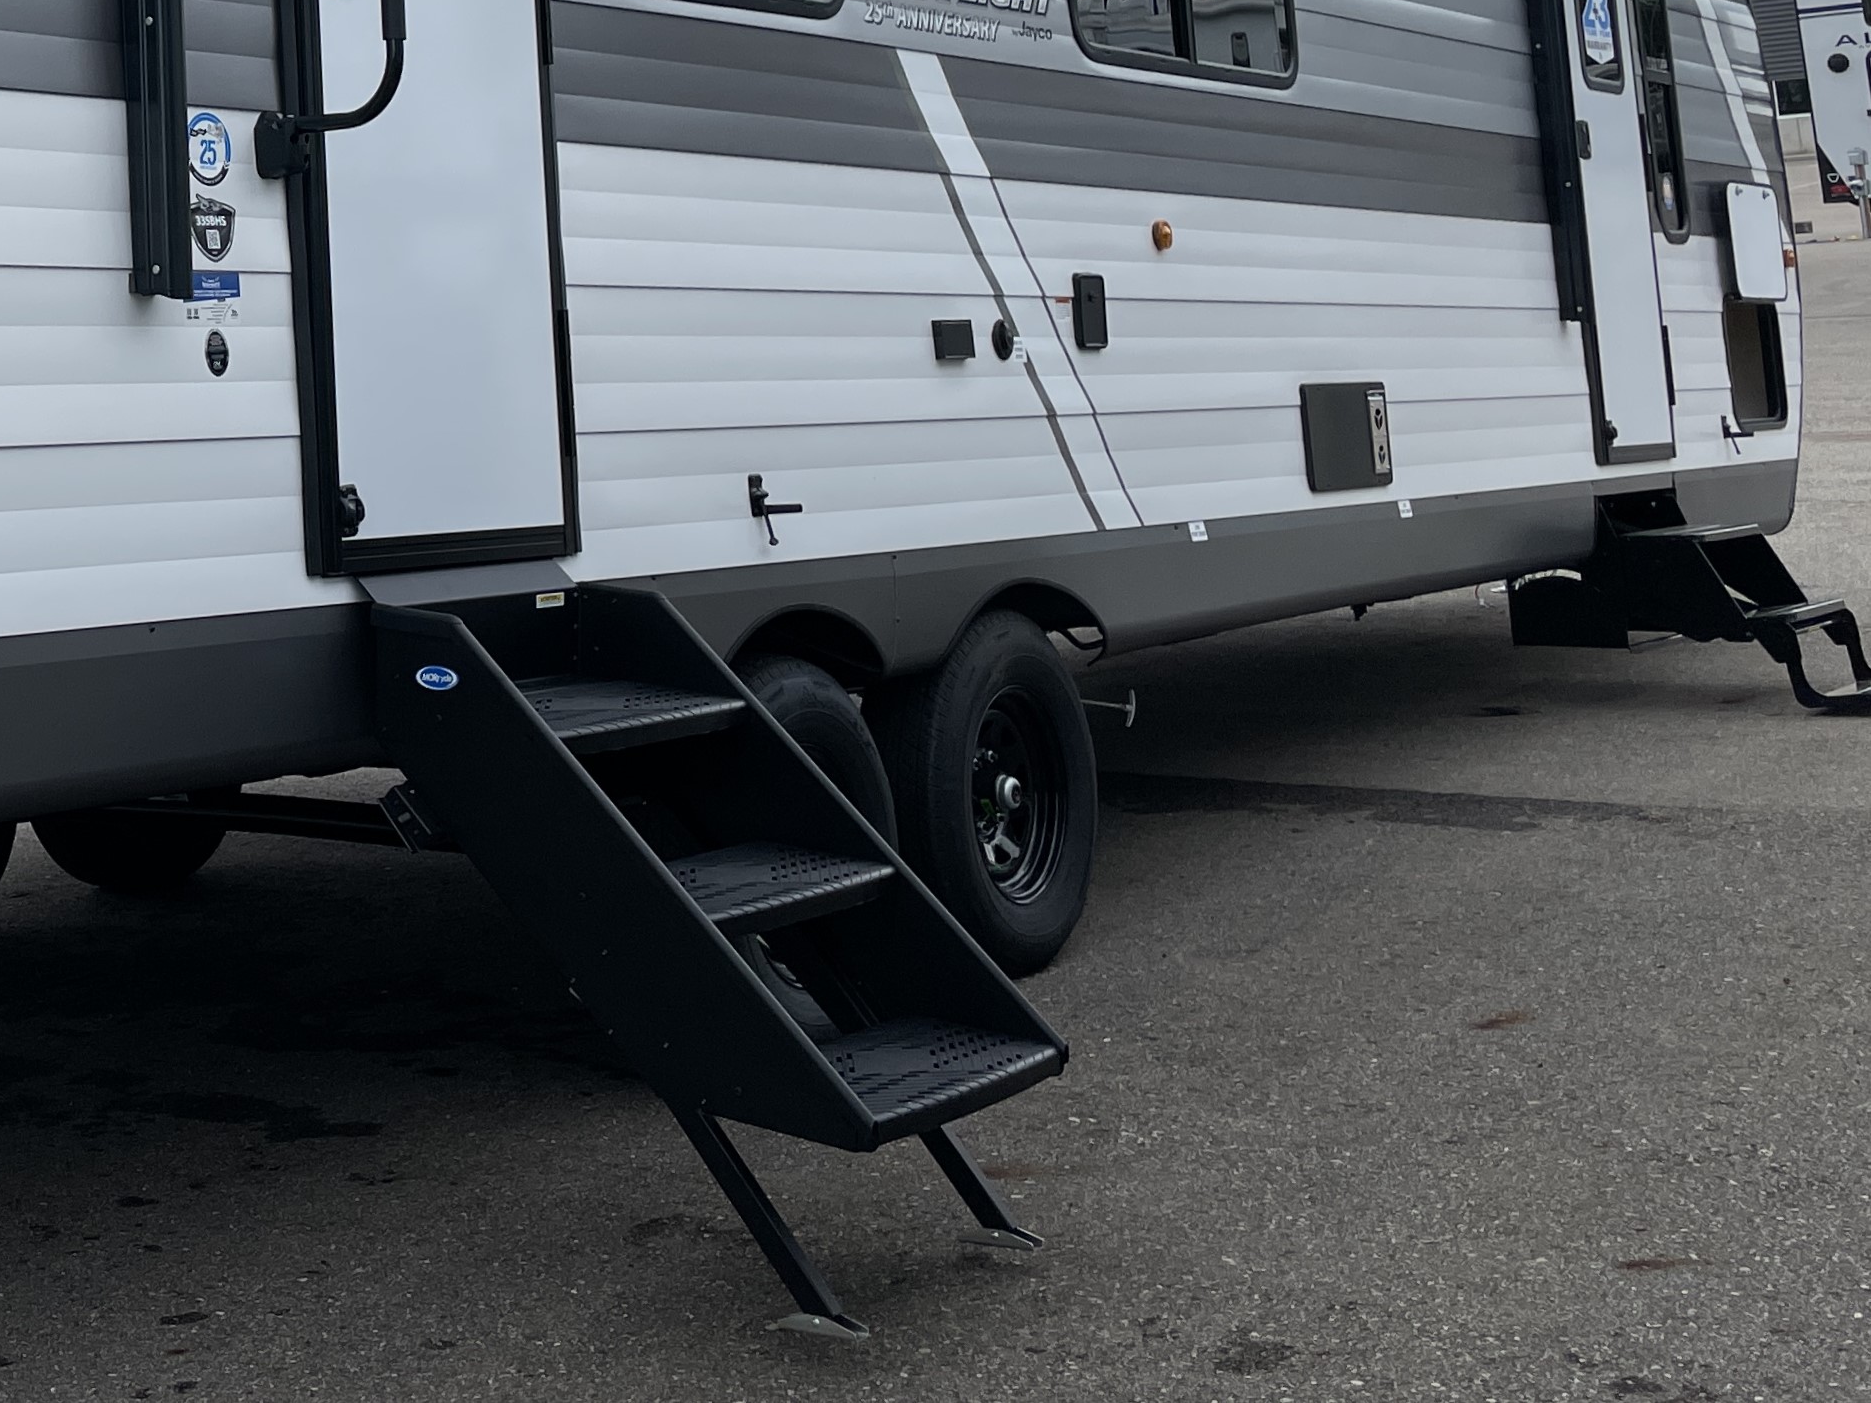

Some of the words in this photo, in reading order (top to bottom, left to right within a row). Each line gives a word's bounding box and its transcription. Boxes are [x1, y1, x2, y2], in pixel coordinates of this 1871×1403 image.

[863, 0, 896, 25] 25th
[895, 6, 1000, 43] ANNIVERSARY
[1019, 20, 1052, 42] Jayco
[199, 139, 217, 165] 25
